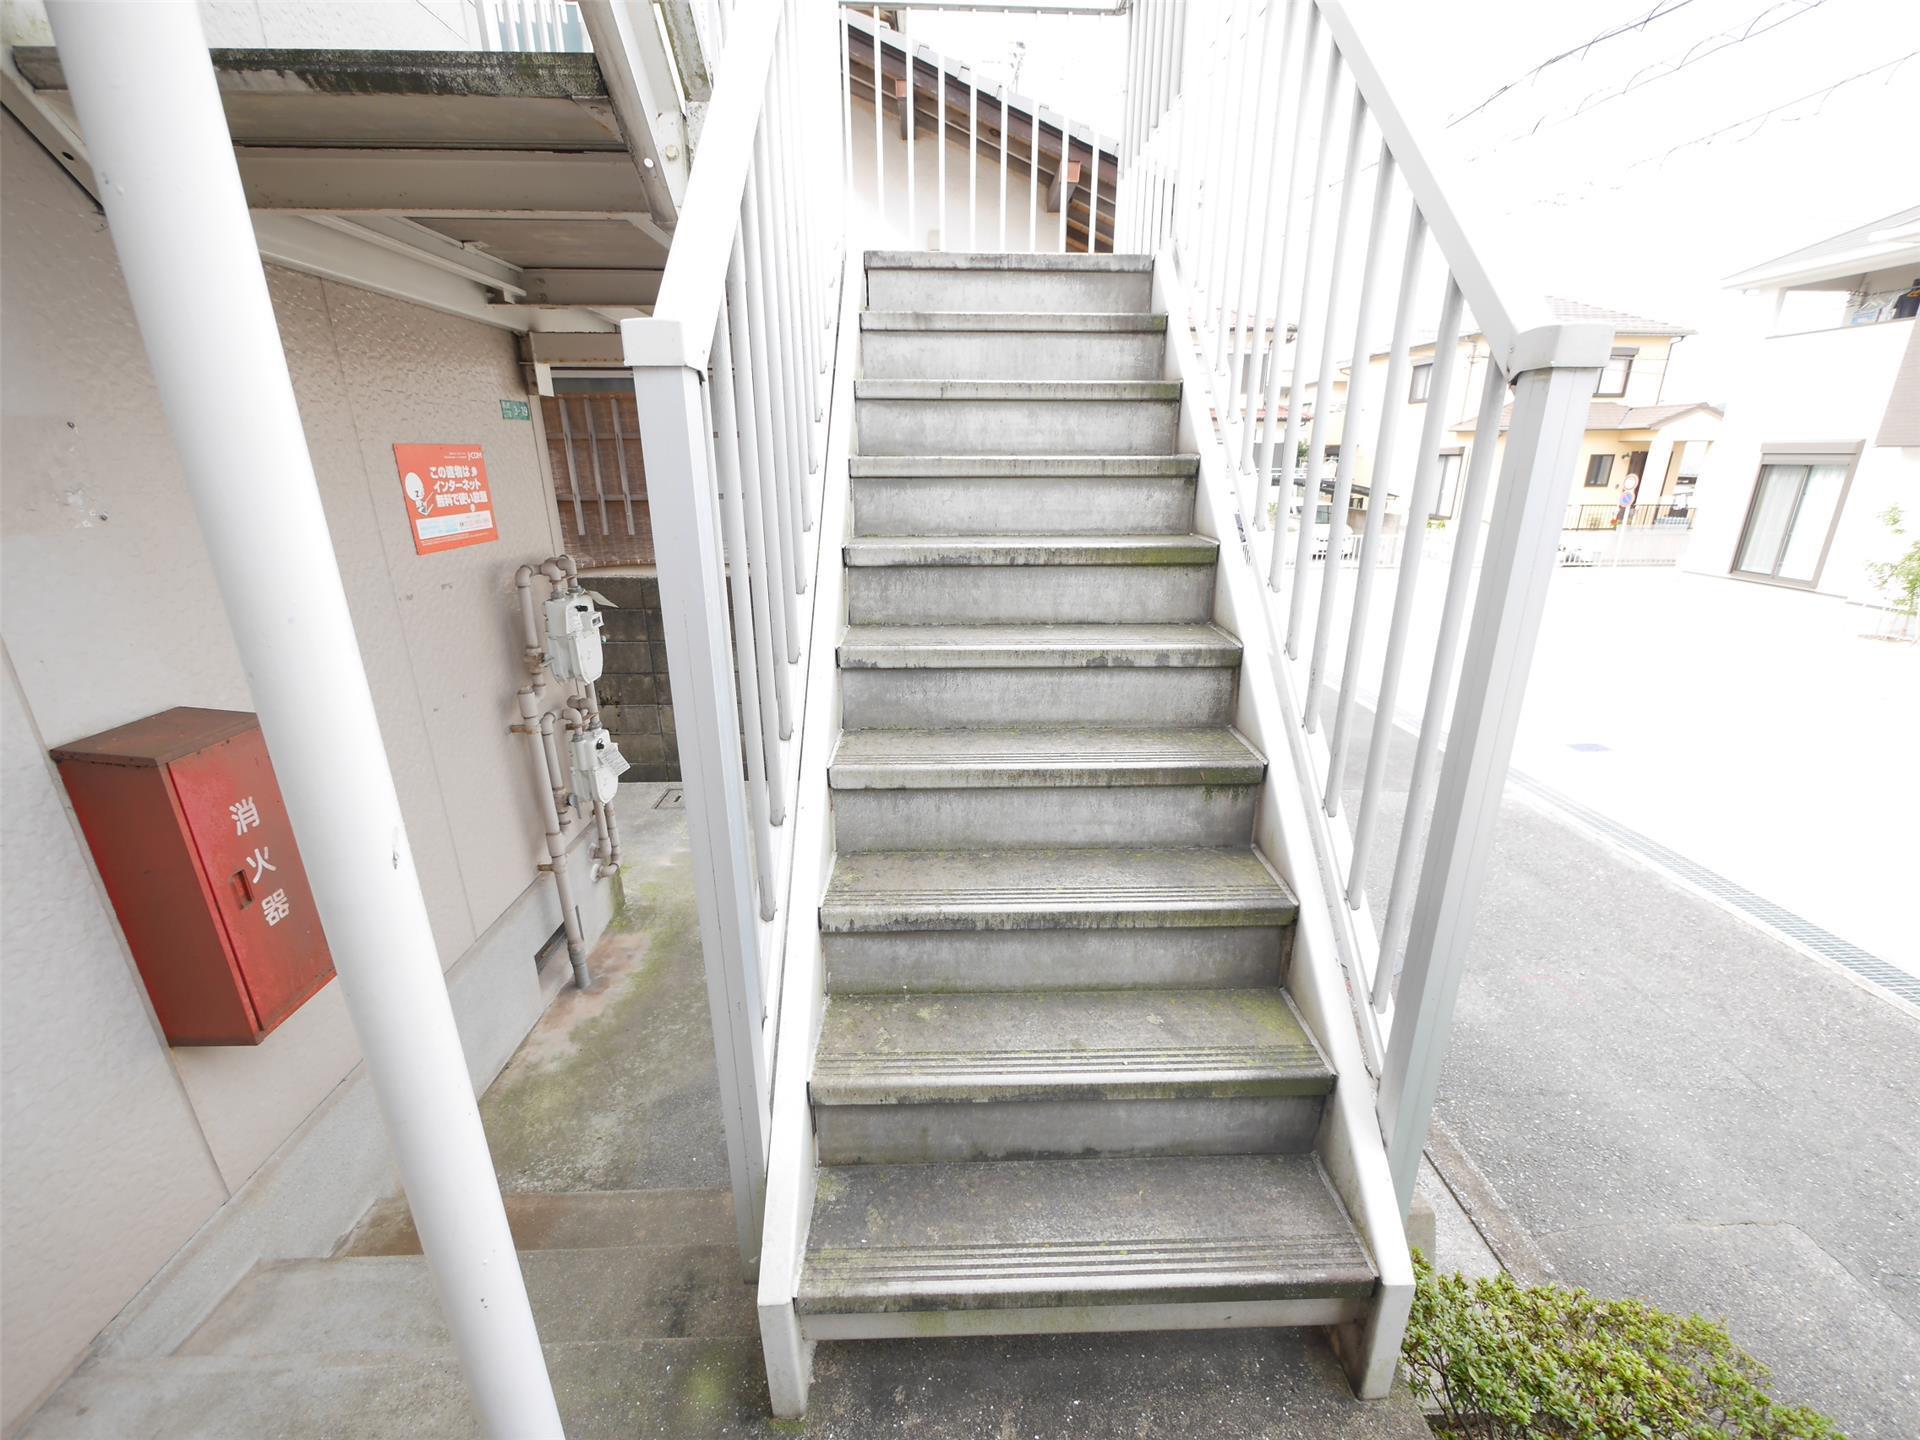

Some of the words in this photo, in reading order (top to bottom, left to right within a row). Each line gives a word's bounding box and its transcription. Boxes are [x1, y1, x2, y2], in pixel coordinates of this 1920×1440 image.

[430, 466, 470, 478] この建物は
[433, 479, 481, 492] インターネット
[436, 491, 488, 507] 無料で使い放題
[229, 796, 290, 927] 消火器
